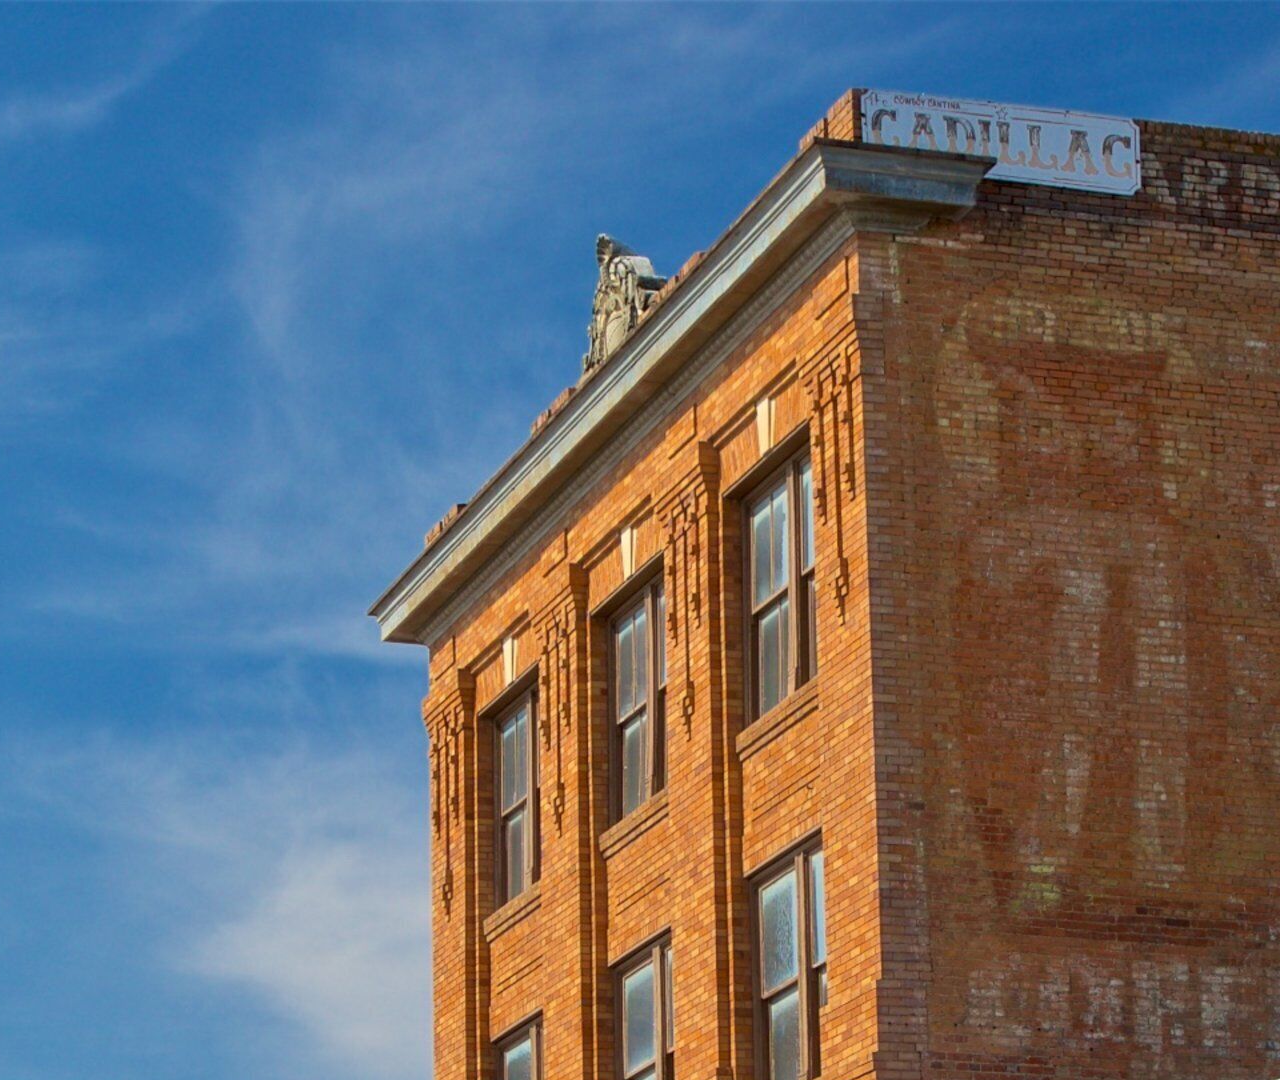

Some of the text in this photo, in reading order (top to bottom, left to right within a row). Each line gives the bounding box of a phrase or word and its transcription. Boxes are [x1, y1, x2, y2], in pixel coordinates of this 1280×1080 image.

[894, 95, 926, 107] COWBOY
[927, 98, 961, 111] CANTINA
[871, 107, 1133, 179] CADILLAC
